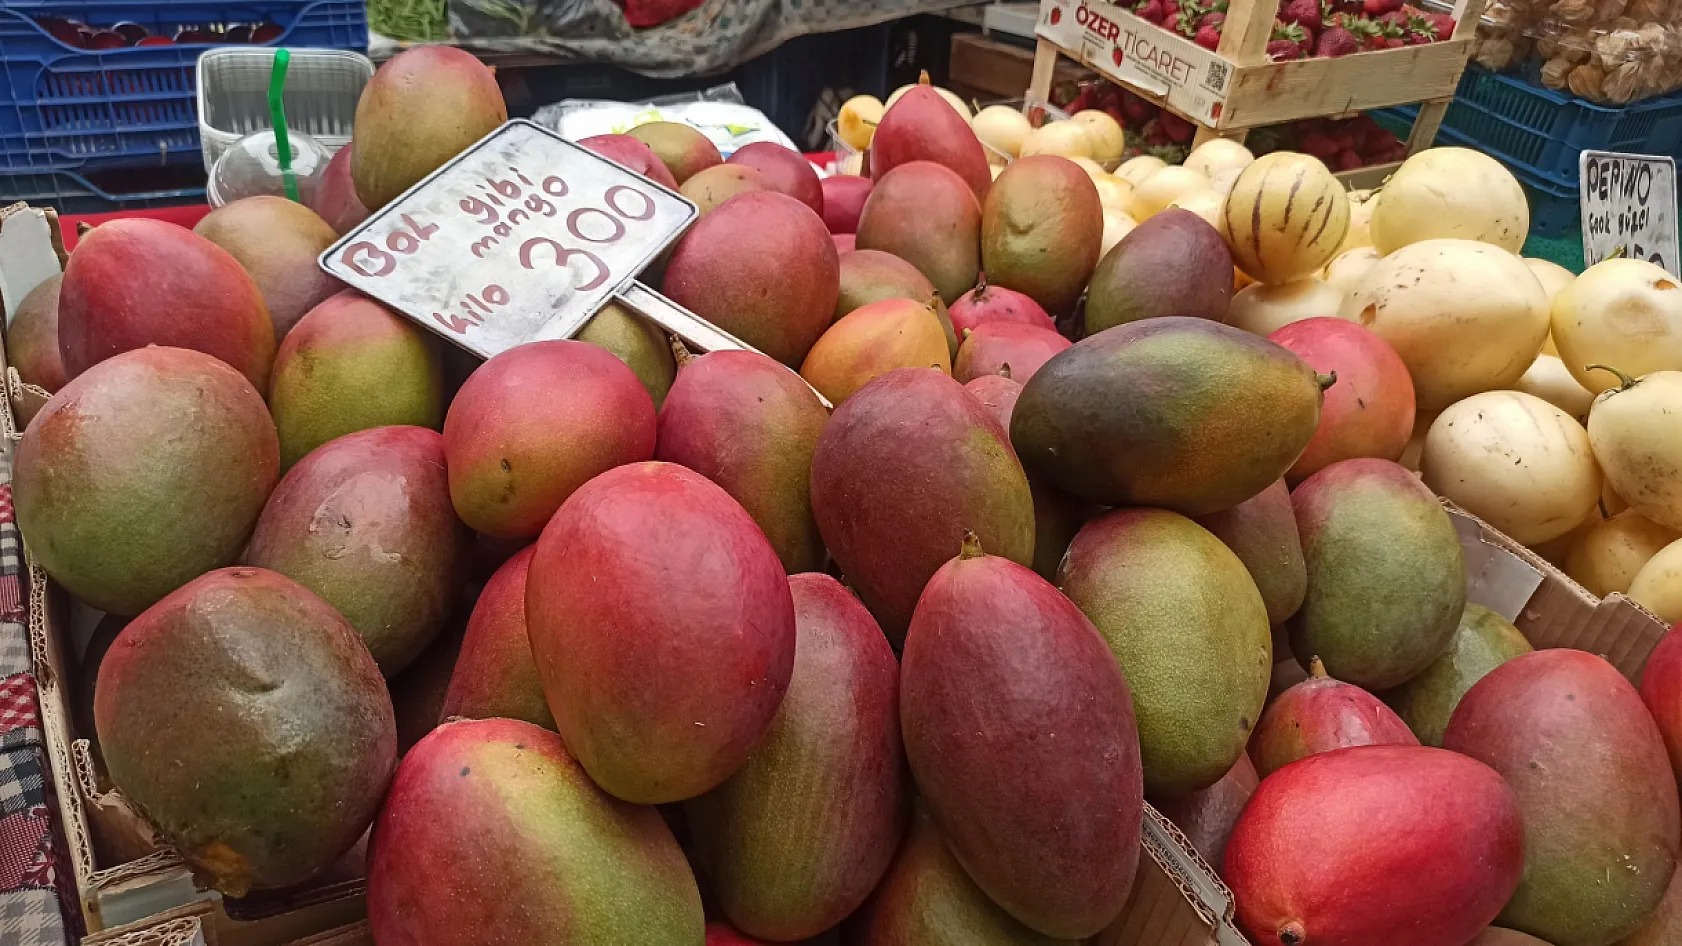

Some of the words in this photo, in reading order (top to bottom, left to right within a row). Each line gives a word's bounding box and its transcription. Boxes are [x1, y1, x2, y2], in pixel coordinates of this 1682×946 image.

[1076, 0, 1120, 45] ÖZER
[459, 166, 534, 225] gibi
[471, 175, 568, 258] mango
[518, 185, 656, 291] 300
